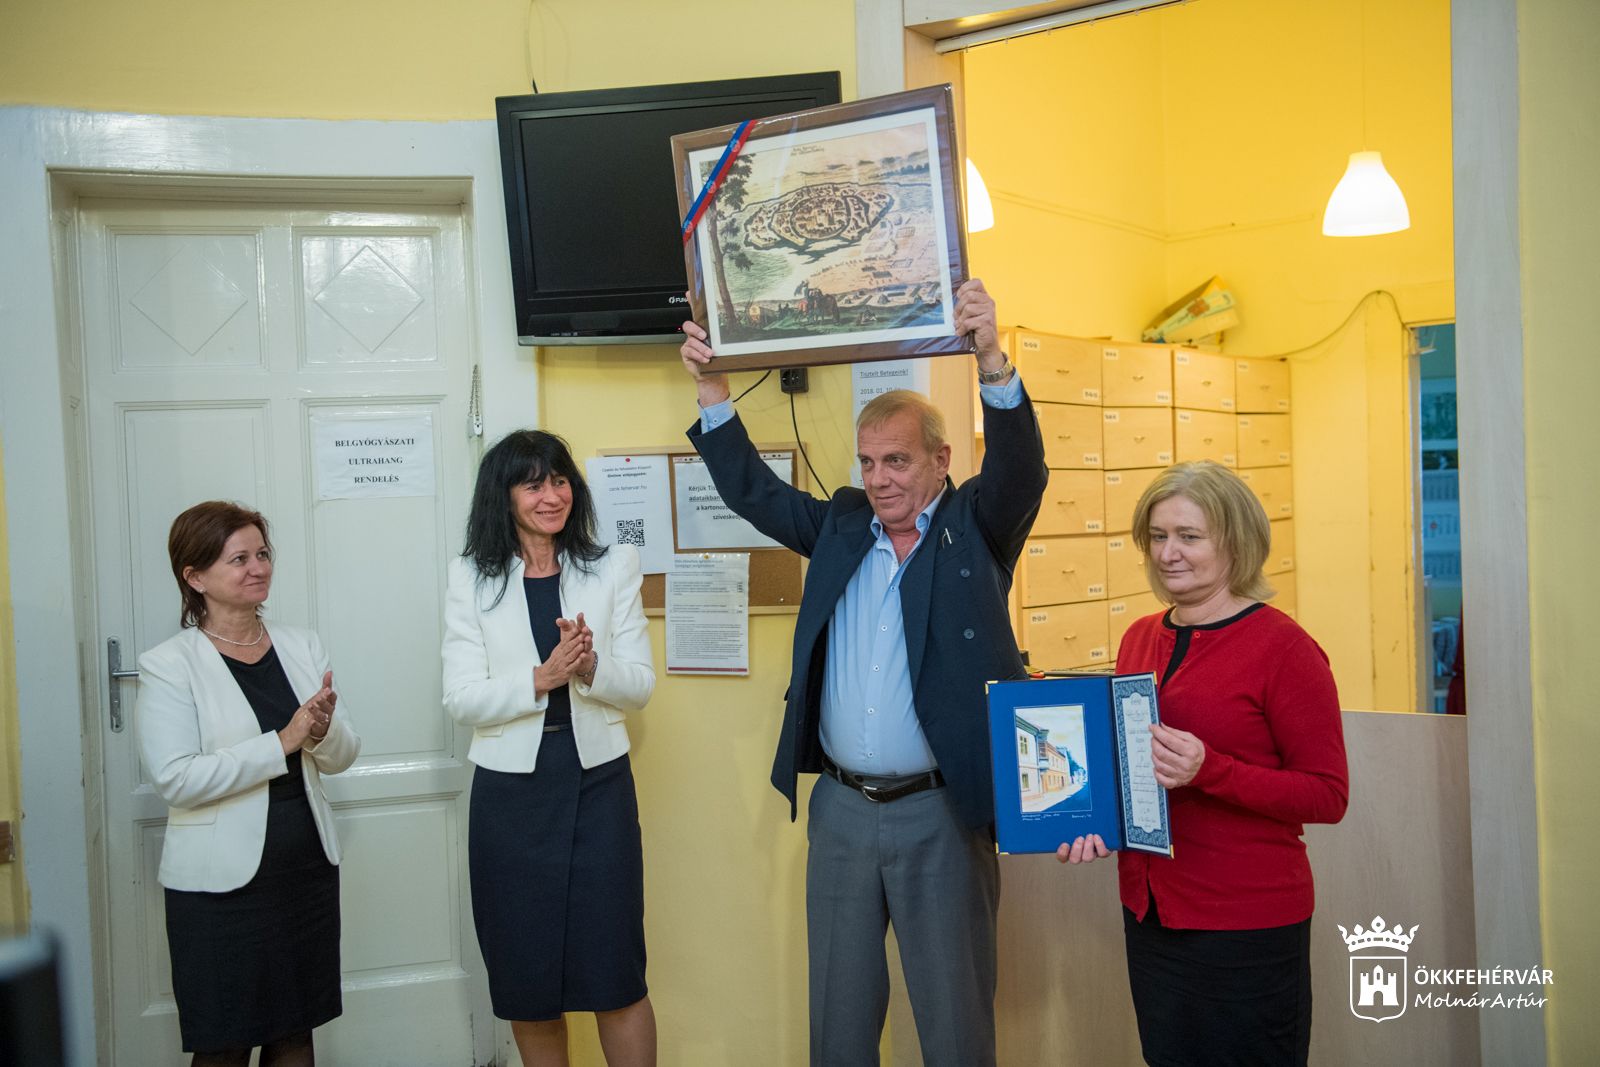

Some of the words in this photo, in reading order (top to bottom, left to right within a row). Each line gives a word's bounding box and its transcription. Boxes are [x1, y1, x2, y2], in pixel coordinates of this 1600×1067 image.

[335, 437, 415, 447] BELGYÓGYÁSZATI
[348, 456, 403, 466] ULTRAHANG
[354, 474, 400, 484] RENDELÉS
